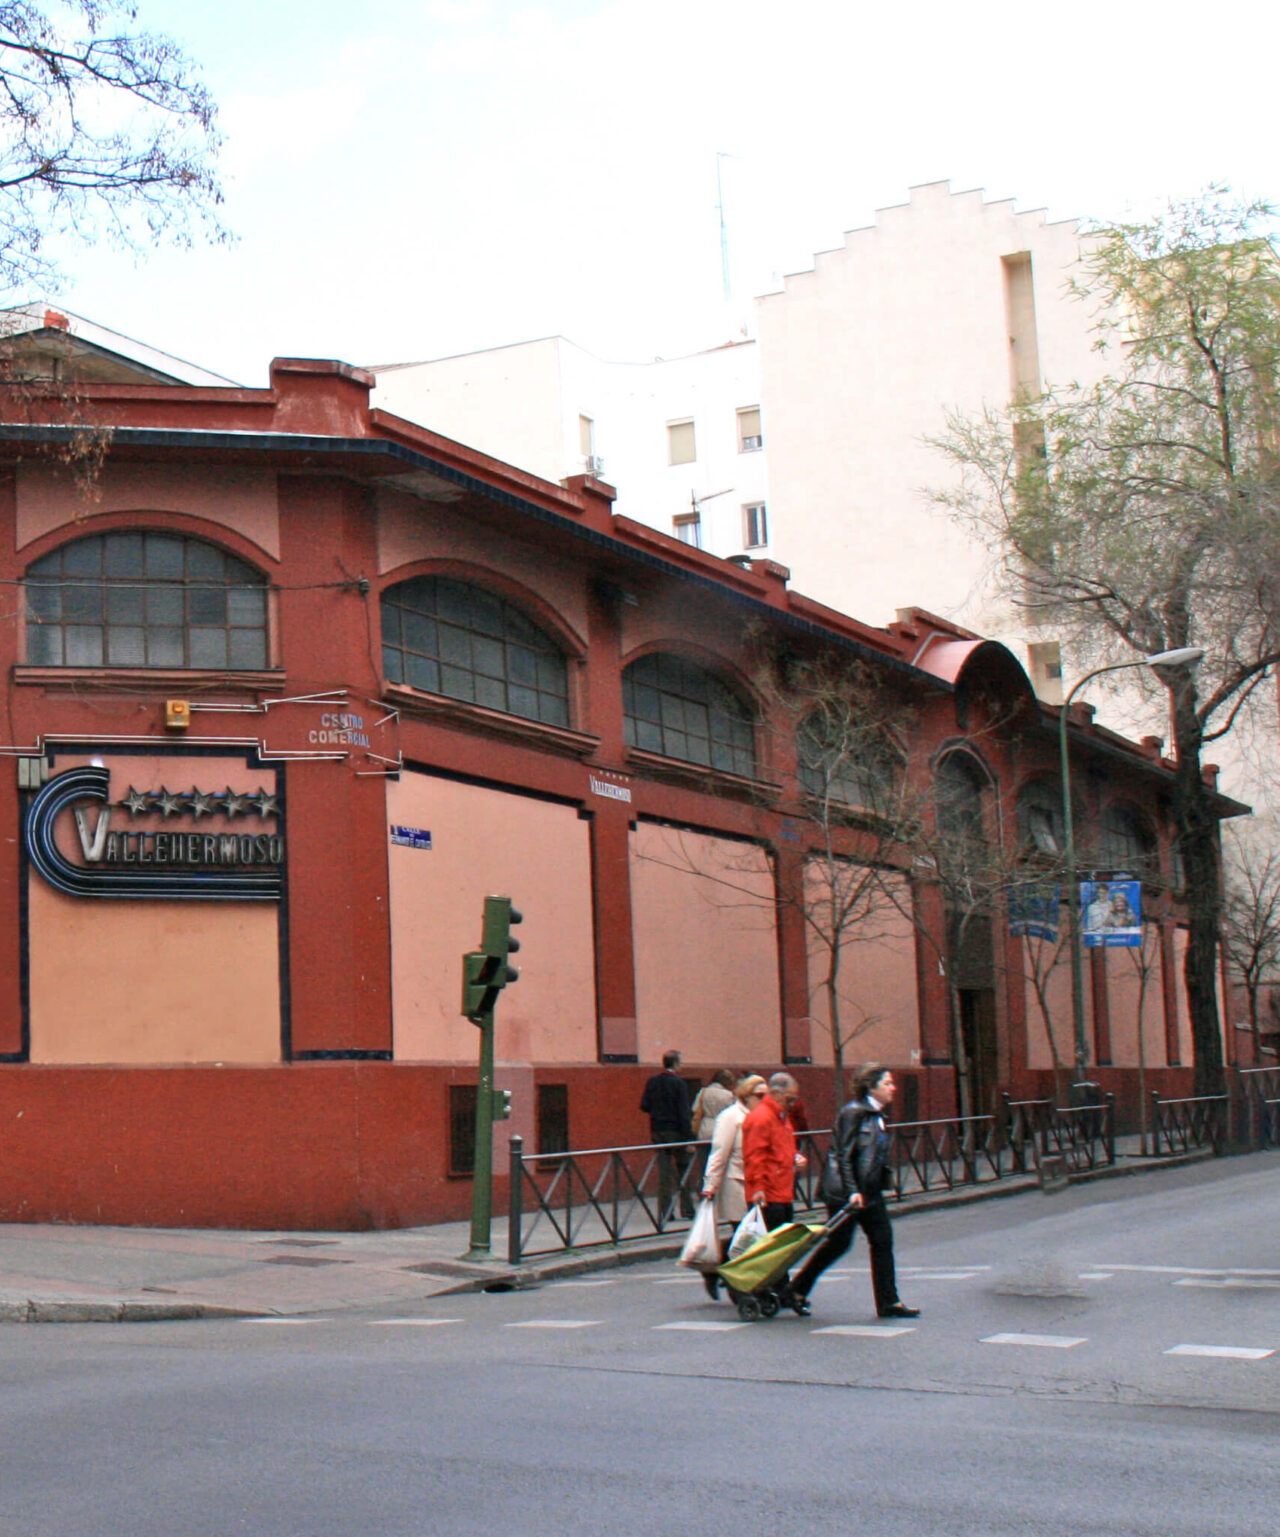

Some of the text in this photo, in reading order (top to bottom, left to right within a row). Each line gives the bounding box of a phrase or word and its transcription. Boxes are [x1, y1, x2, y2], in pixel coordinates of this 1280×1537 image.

[321, 713, 364, 730] CENTRO
[309, 730, 371, 748] COMERCIAL
[72, 806, 284, 864] VALLEHERMOSO
